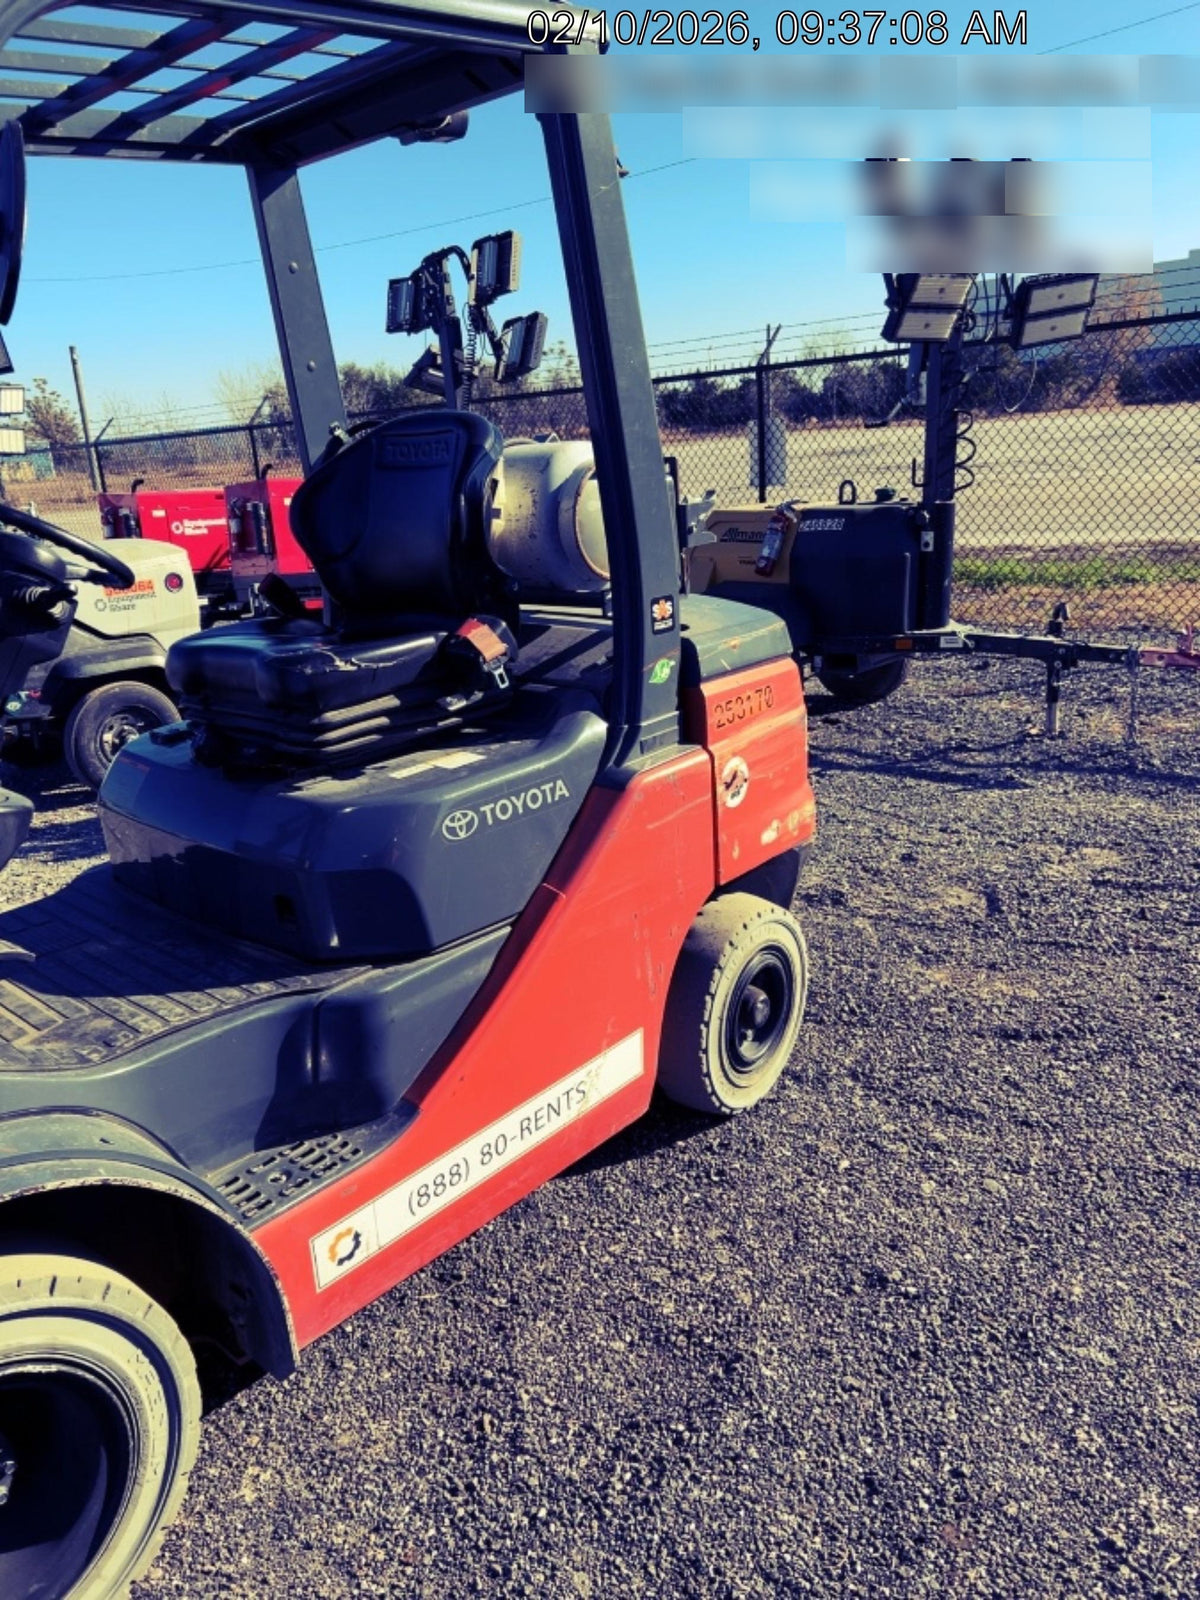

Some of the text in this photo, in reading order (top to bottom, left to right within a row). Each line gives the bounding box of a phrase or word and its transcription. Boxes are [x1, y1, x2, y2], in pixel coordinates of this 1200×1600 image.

[386, 440, 449, 462] TOYOTA
[714, 685, 773, 728] 253170
[480, 779, 569, 825] TOYOTA
[407, 1079, 587, 1216] (888) 80-RENTS
